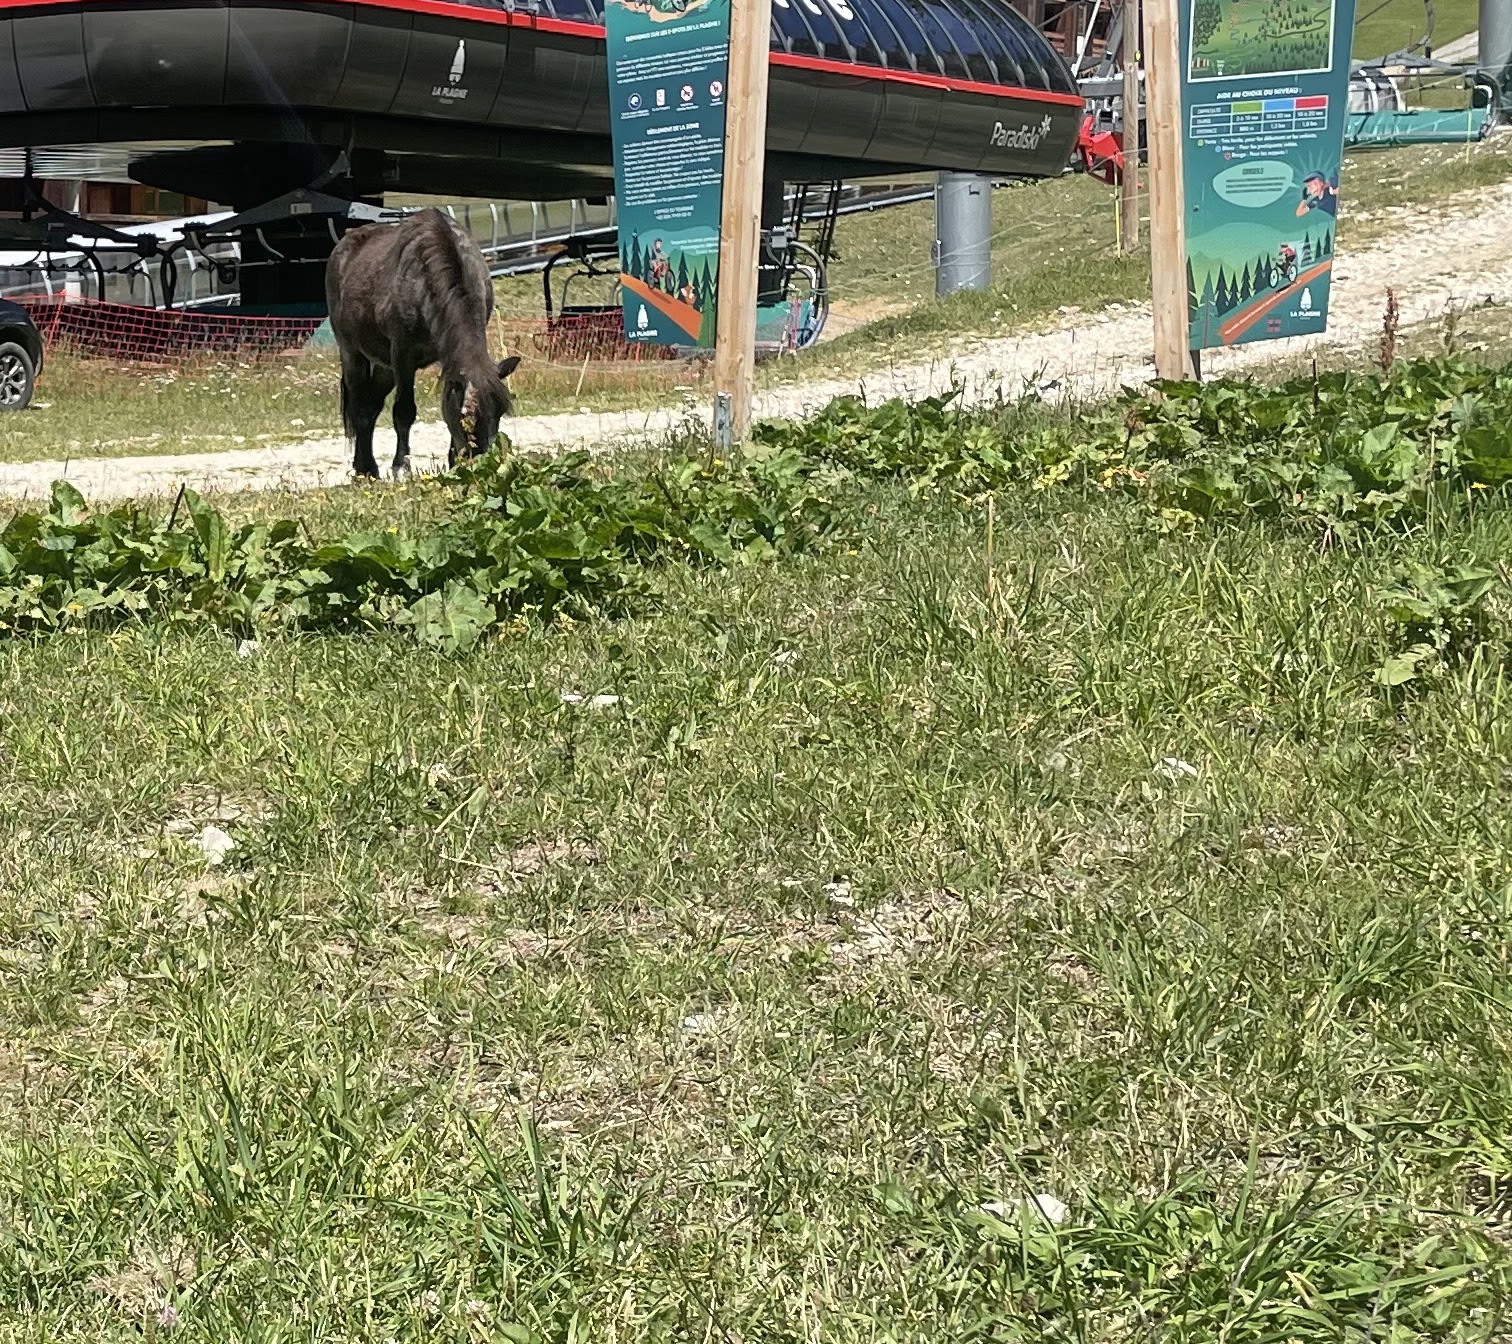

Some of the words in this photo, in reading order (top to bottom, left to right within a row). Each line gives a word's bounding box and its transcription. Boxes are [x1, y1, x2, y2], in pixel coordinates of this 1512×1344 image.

[432, 86, 441, 96] LA
[442, 87, 468, 98] PLAGNE
[990, 122, 1039, 149] Paradiski
[636, 329, 657, 337] PLAGNE
